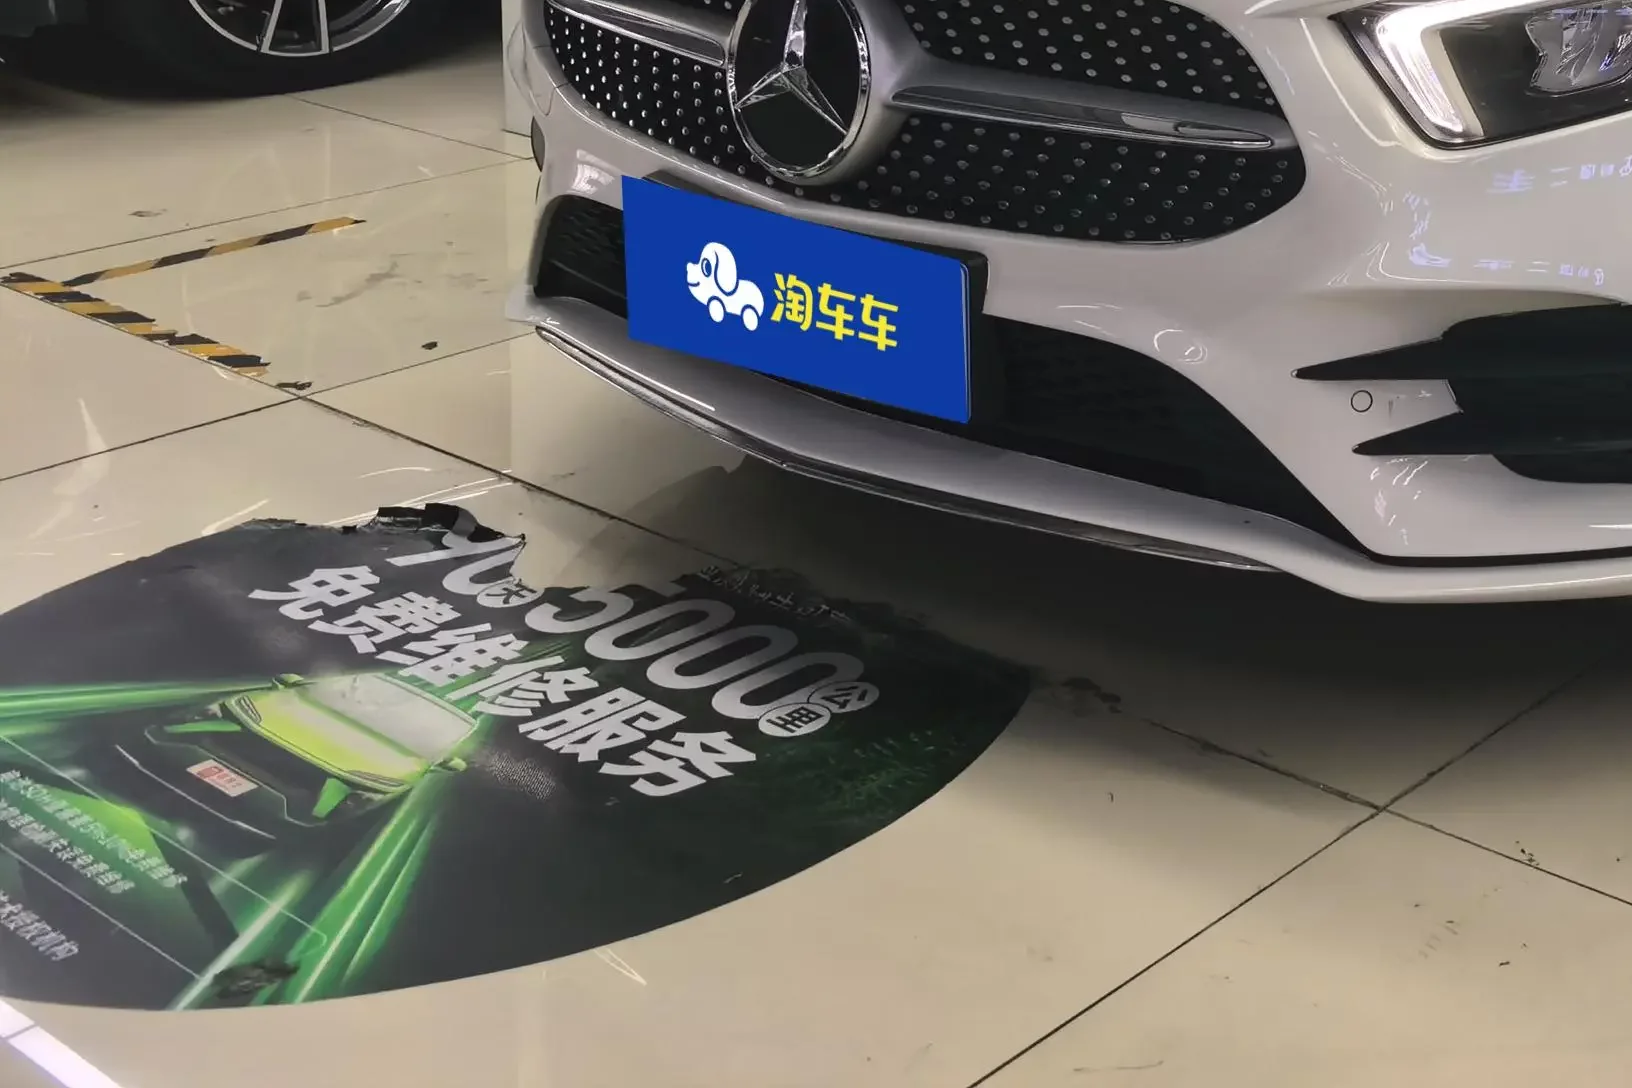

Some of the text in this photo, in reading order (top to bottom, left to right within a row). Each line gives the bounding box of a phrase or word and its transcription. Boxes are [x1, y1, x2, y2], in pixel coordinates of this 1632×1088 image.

[248, 565, 757, 797] 免费维修服务
